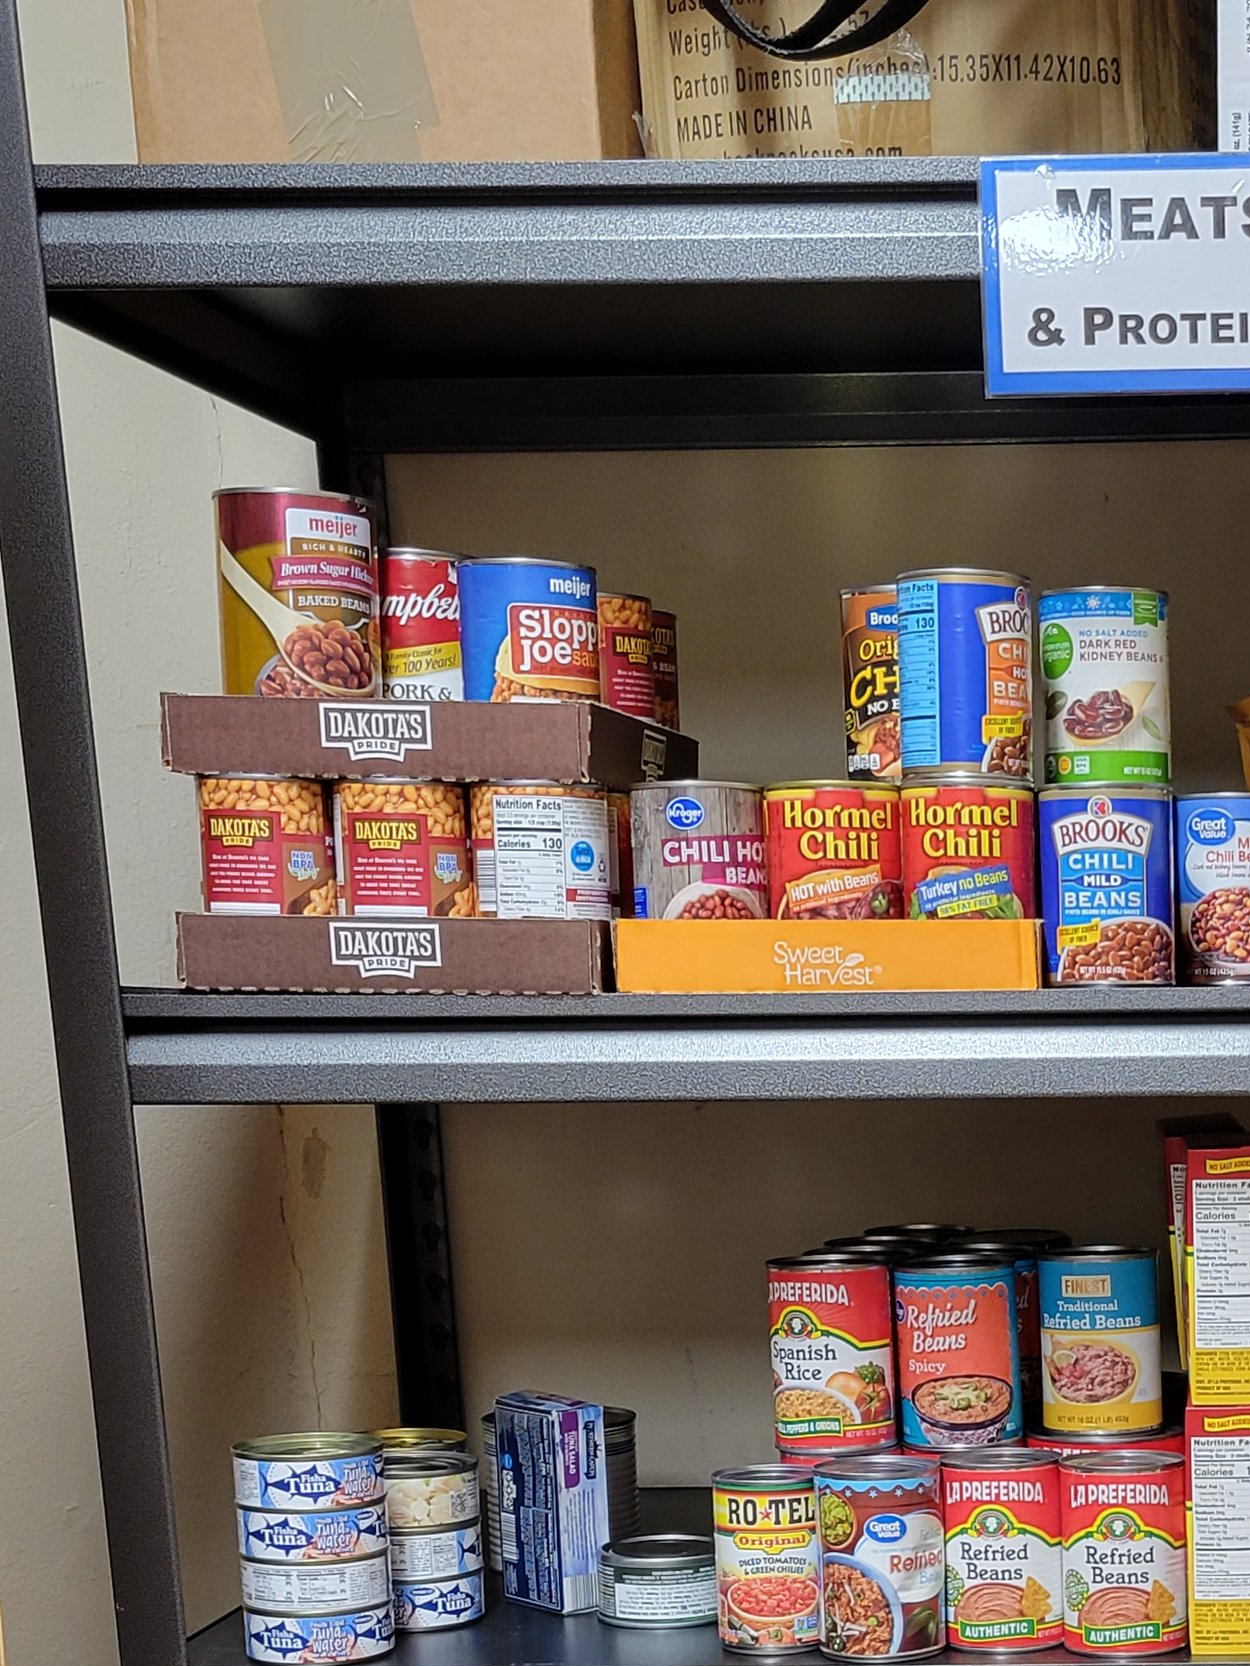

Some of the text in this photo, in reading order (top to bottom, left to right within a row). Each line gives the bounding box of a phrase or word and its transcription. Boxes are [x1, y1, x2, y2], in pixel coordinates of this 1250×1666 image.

[678, 105, 812, 142] MADE IN CHINA
[1027, 307, 1066, 347] &
[309, 516, 358, 538] meijer
[550, 576, 591, 599] meijer
[1079, 630, 1149, 639] NO SALT ADDED
[1079, 639, 1137, 650] DARK RED
[519, 640, 572, 671] Joe
[1079, 652, 1159, 663] KIDNEY BEANS
[326, 710, 424, 741] DAKOTA'S
[356, 739, 397, 752] PRIDE
[496, 799, 561, 811] Nutrition Facts
[909, 799, 1018, 828] Hormel
[783, 800, 892, 830] Hormel
[210, 818, 270, 837] DAKOTA'S
[355, 821, 417, 840] DAKOTA'S
[1191, 817, 1227, 831] Great
[1059, 819, 1147, 847] BROOKS
[1199, 828, 1227, 839] Value
[497, 838, 562, 849] Calories 130
[799, 830, 880, 861] Chili
[923, 828, 1001, 859] Chili
[1068, 853, 1134, 870] CHILI
[1083, 874, 1121, 887] MILD
[1064, 892, 1142, 907] BEANS
[338, 928, 434, 958] DAKOTA'S
[773, 940, 843, 966] Sweet
[367, 958, 409, 970] PRIDE
[784, 963, 875, 986] Harvest
[1195, 1181, 1237, 1189] Nutrition
[1195, 1211, 1236, 1221] Calories
[1064, 1277, 1110, 1294] FINEST
[907, 1299, 977, 1328] Refried
[1057, 1300, 1118, 1311] Traditional
[1043, 1313, 1142, 1328] Refried Beans
[912, 1332, 967, 1353] Beans
[773, 1340, 838, 1363] Spanish
[784, 1362, 823, 1381] Rice
[908, 1358, 946, 1374] Spicy
[1194, 1438, 1236, 1448] Nutrition
[1194, 1468, 1234, 1477] Calories
[284, 1479, 341, 1496] Tuna
[259, 1530, 308, 1547] Tuna
[738, 1532, 807, 1549] Original
[960, 1542, 1029, 1562] Refried
[1085, 1546, 1155, 1565] Refried
[965, 1563, 1024, 1582] Beans
[1091, 1567, 1150, 1585] Beans
[964, 1623, 1029, 1638] AUTHENTIC
[1089, 1626, 1155, 1642] AUTHENTIC
[260, 1634, 304, 1650] Tuna
